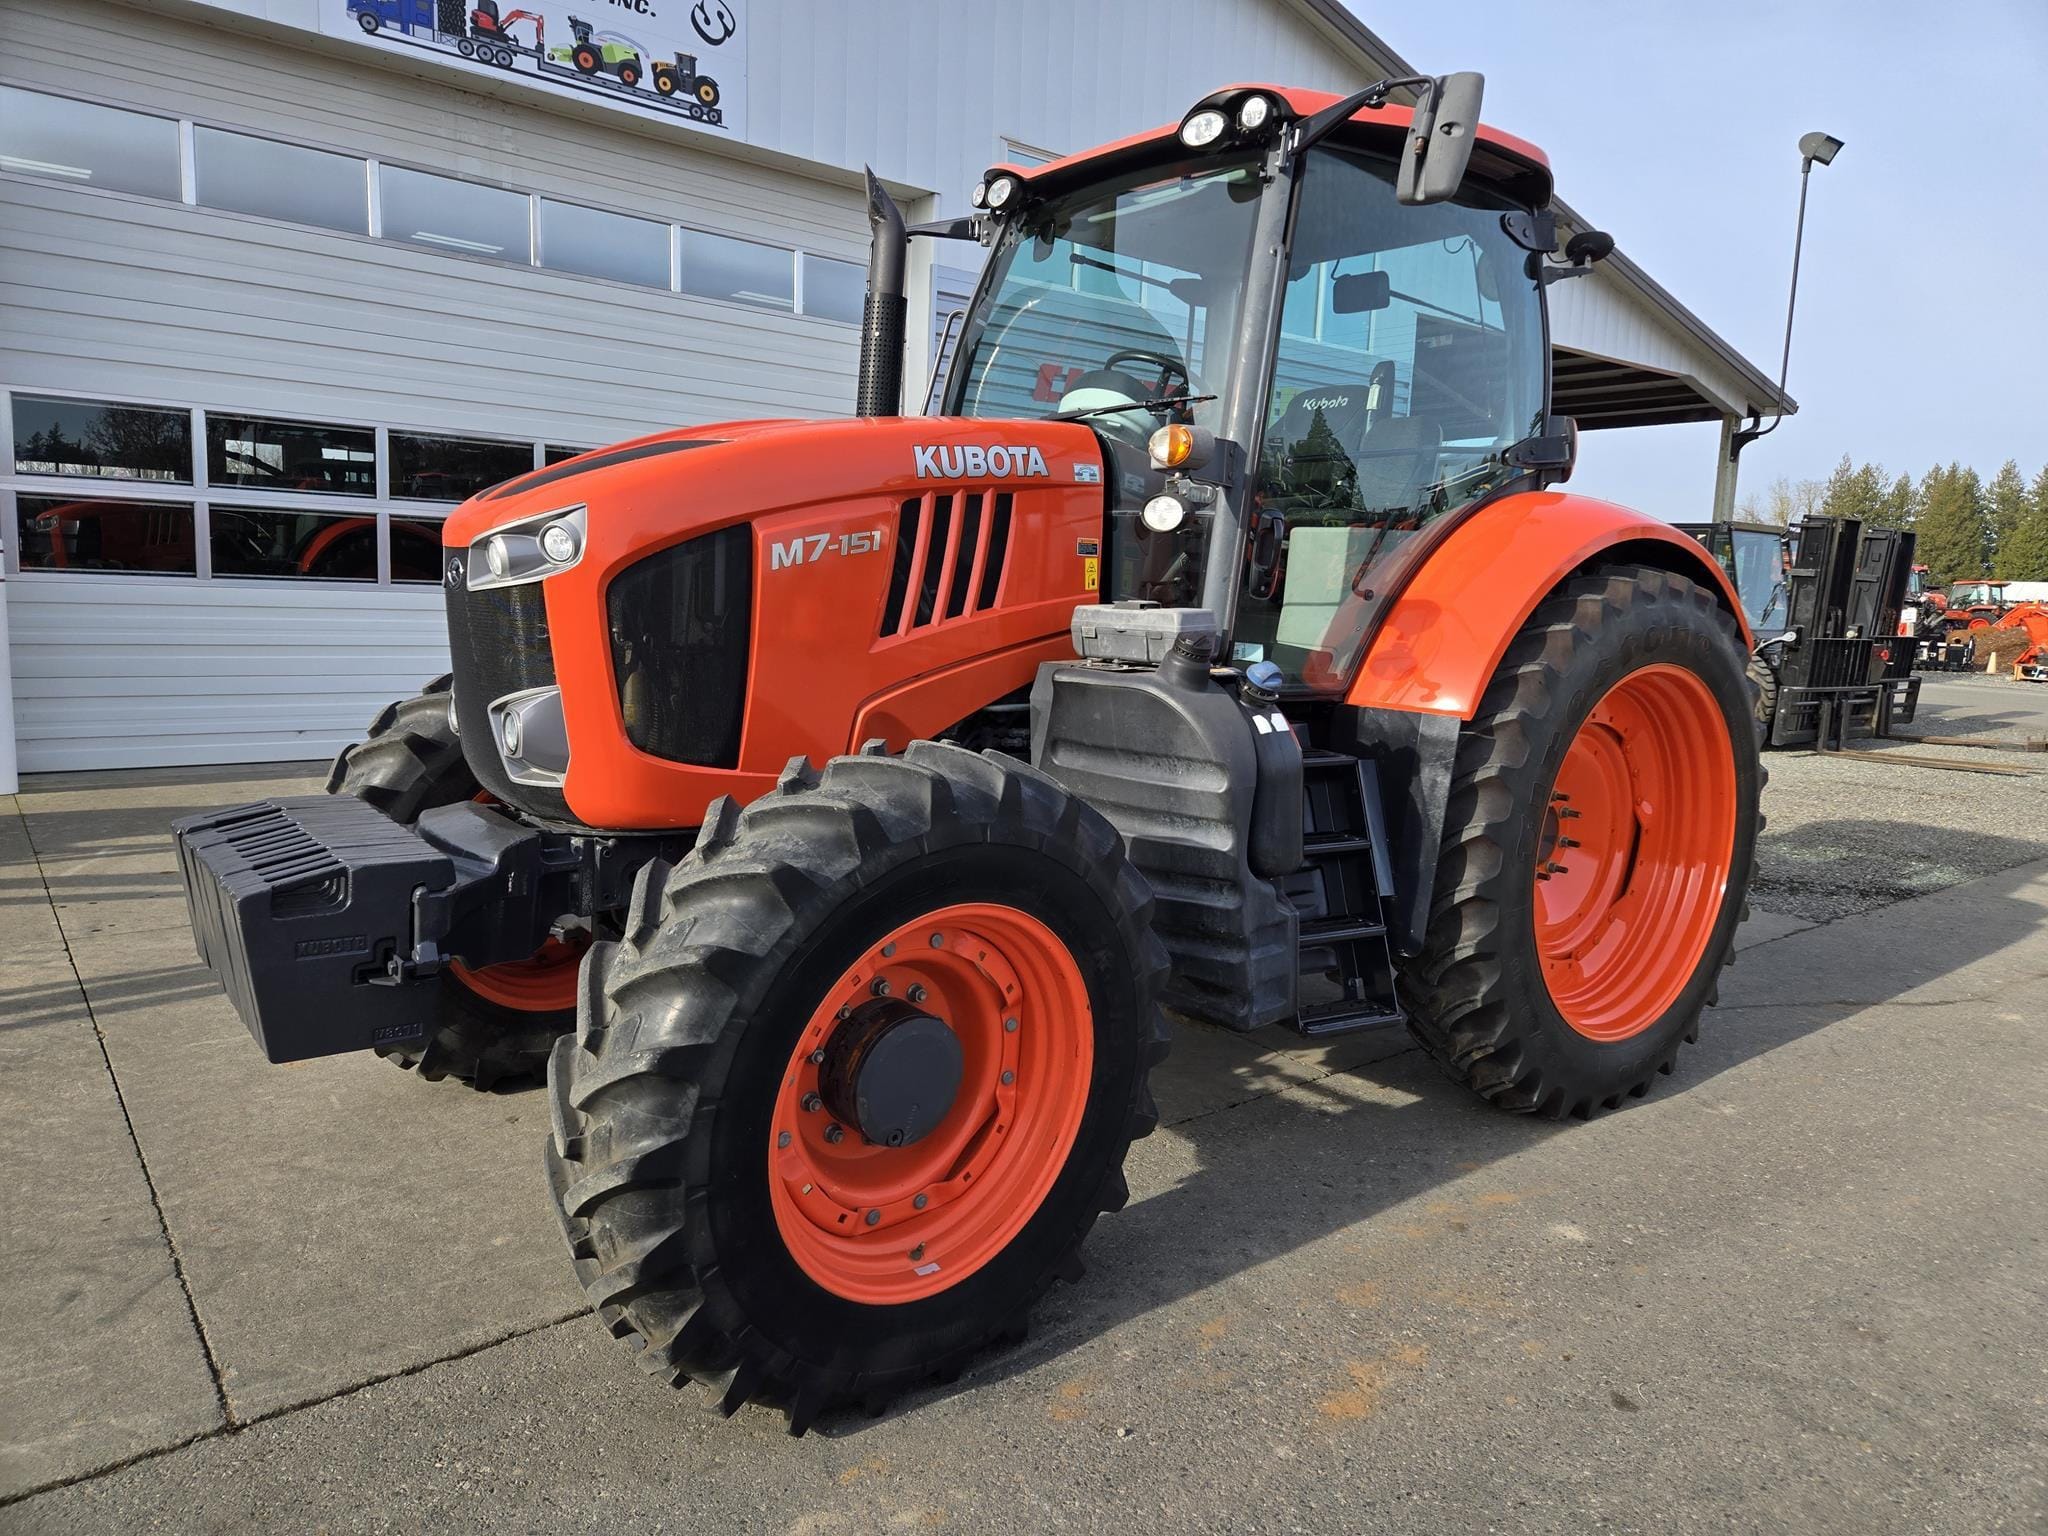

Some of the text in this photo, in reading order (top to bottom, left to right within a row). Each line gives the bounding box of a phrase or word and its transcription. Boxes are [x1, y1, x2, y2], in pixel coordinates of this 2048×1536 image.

[608, 0, 657, 17] NC.
[1302, 395, 1349, 411] Kubota
[913, 445, 1049, 479] KUBOTA
[770, 530, 881, 570] M7-151
